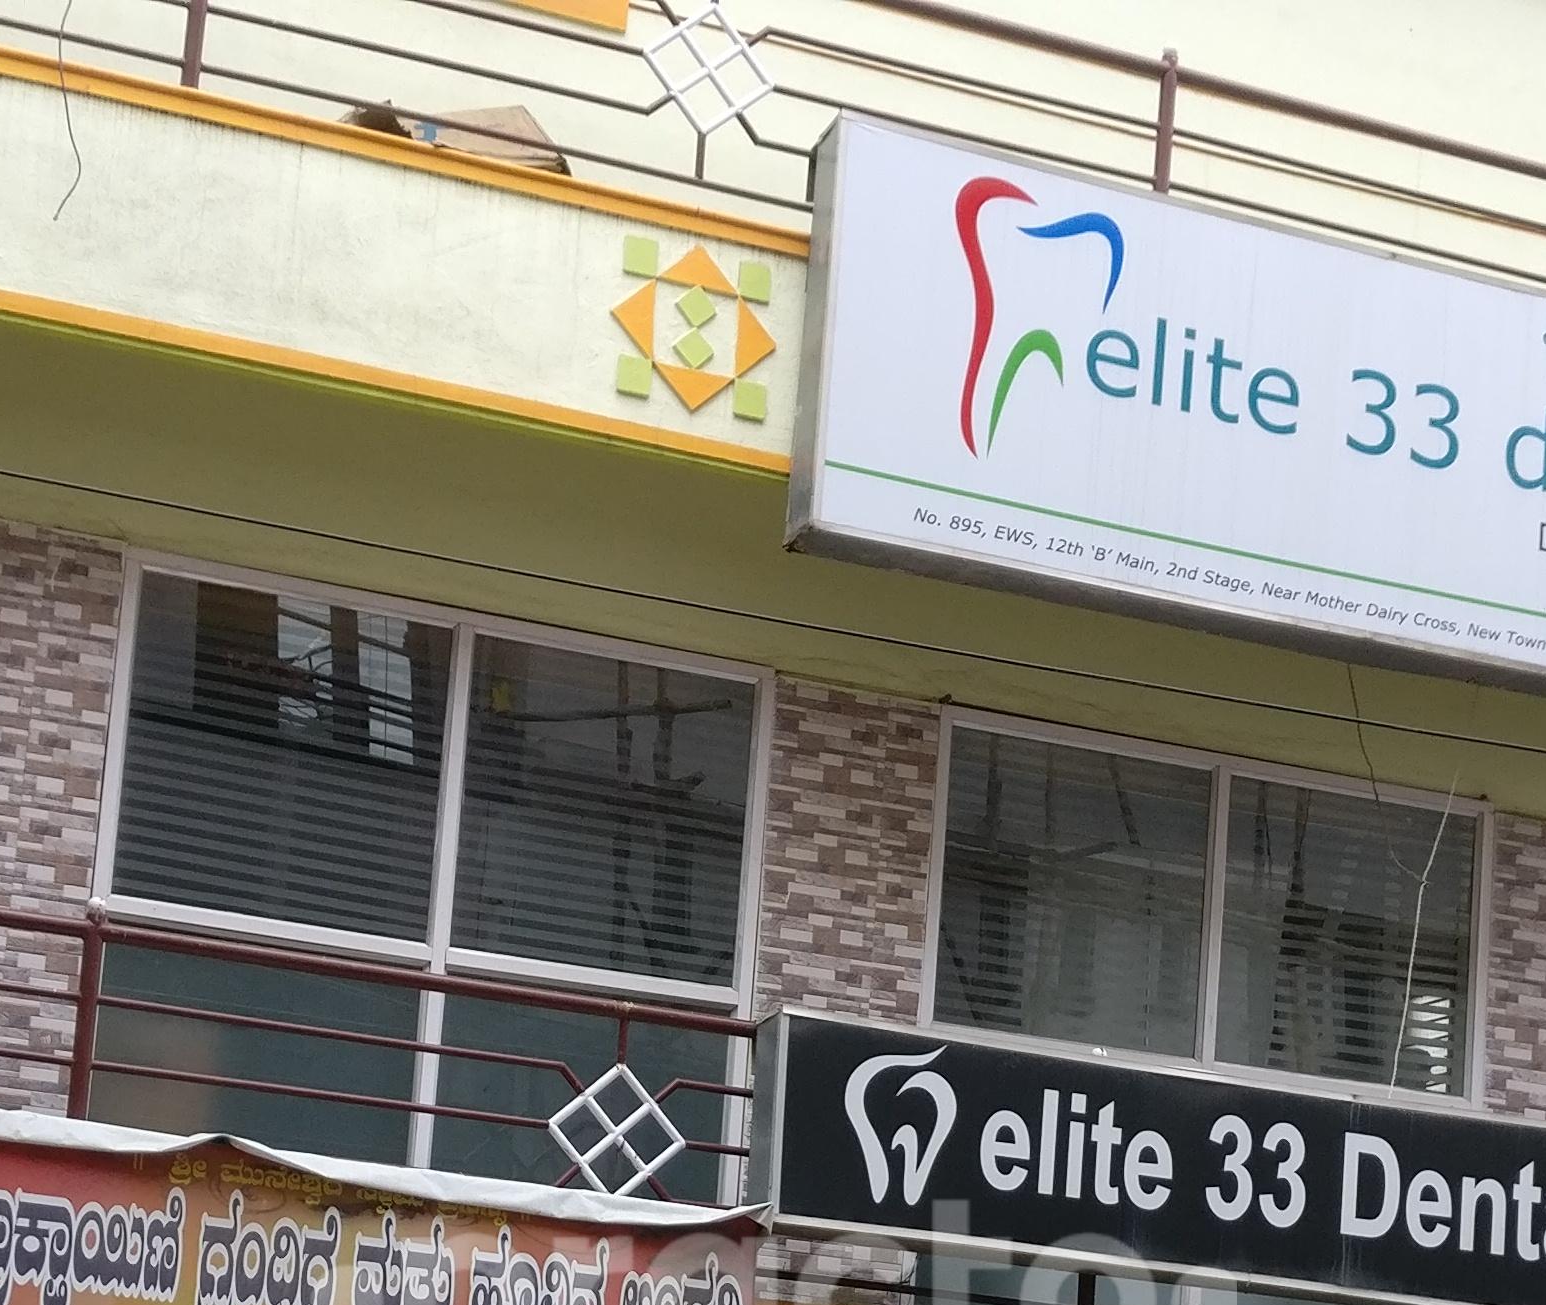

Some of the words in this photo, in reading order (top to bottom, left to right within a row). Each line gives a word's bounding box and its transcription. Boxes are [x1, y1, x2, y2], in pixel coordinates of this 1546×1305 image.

[1085, 317, 1300, 435] elite
[1346, 368, 1460, 470] 33
[913, 507, 941, 527] No.
[949, 515, 987, 538] 895,
[994, 525, 1038, 549] EWS,
[1045, 537, 1084, 558] 12th
[1116, 551, 1159, 576] Main,
[1166, 562, 1199, 581] 2nd
[1203, 569, 1255, 595] Stage,
[1261, 581, 1301, 601] Near
[1305, 590, 1363, 613] Mother
[1366, 602, 1409, 626] Dairy
[1414, 612, 1462, 636] Cross,
[1467, 622, 1501, 641] New
[1506, 630, 1546, 652] Town
[979, 1088, 1174, 1212] elite
[1205, 1115, 1307, 1229] 33
